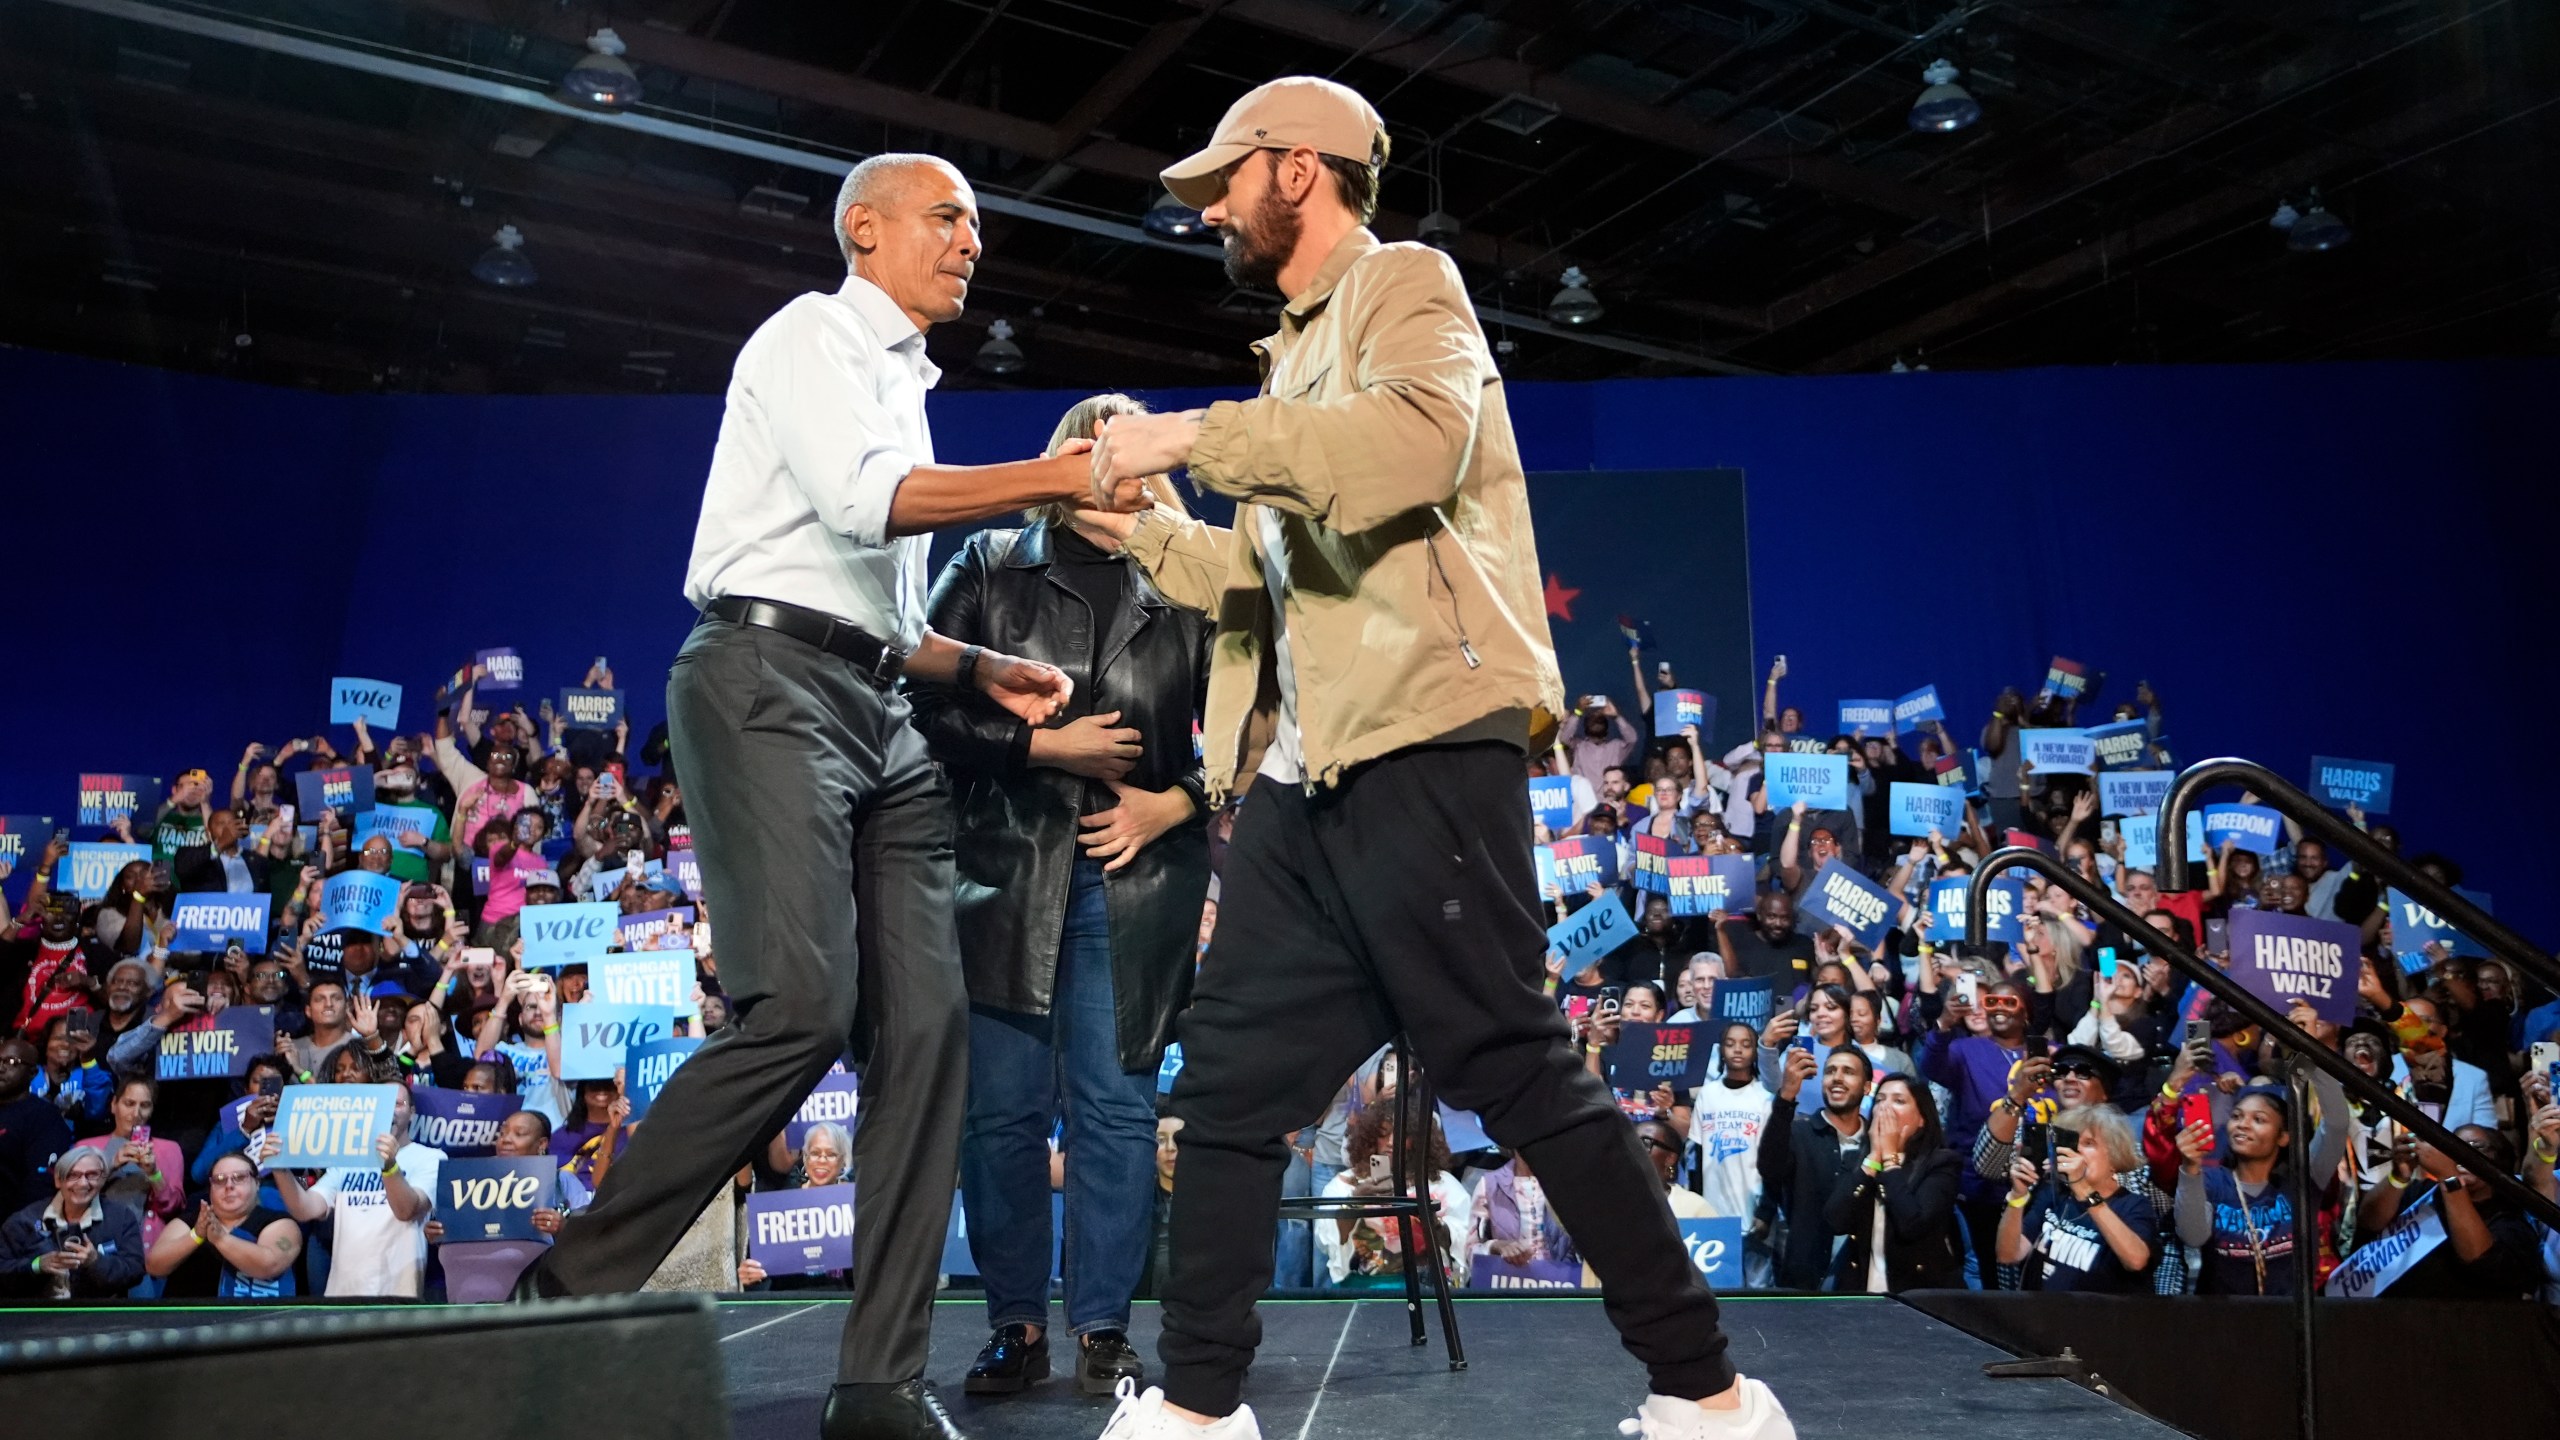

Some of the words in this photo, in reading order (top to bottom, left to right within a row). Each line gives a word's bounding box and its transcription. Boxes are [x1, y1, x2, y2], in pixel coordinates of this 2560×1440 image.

[341, 688, 392, 709] vote
[568, 695, 615, 713] HARRIS
[1676, 692, 1703, 704] YES
[574, 711, 608, 722] WALZ
[1676, 702, 1703, 715] SHE
[1842, 708, 1889, 723] FREEDOM
[1790, 738, 1827, 754] ote
[2033, 743, 2040, 752] A
[2042, 743, 2064, 754] NEW
[2066, 743, 2089, 755] WAY
[2037, 753, 2085, 765] FORWARD
[2104, 751, 2139, 765] WALZ
[1780, 766, 1831, 784] HARRIS
[2320, 766, 2382, 792] HARRIS
[323, 781, 352, 795] SHE
[1788, 785, 1823, 795] WALZ
[2109, 783, 2116, 793] A
[2118, 782, 2141, 794] NEW
[2328, 787, 2370, 802] WALZ
[80, 791, 102, 808] WE
[105, 791, 139, 811] VOTE,
[323, 791, 354, 806] CAN
[1906, 796, 1953, 816] HARRIS
[80, 808, 101, 825] WE
[372, 814, 421, 832] HARRIS
[1913, 814, 1945, 825] WALZ
[2206, 812, 2275, 838] FREEDOM
[1571, 854, 1602, 874] VOTE,
[1668, 878, 1691, 896] WE
[1692, 875, 1730, 896] VOTE,
[330, 884, 383, 907] HARRIS
[1823, 872, 1889, 924] HARRIS
[334, 903, 372, 916] WALZ
[1670, 896, 1692, 915] WE
[1694, 895, 1724, 913] WIN
[1825, 896, 1872, 932] WALZ
[177, 906, 262, 931] FREEDOM
[534, 913, 605, 942] vote
[1555, 907, 1615, 958] vote
[307, 944, 324, 959] TO
[324, 947, 344, 963] MY
[2254, 934, 2343, 979] HARRIS
[604, 960, 681, 976] MICHIGAN
[605, 972, 682, 1006] VOTE!
[2271, 971, 2332, 999] WALZ
[579, 1016, 660, 1049] vote
[1655, 1029, 1692, 1044] YES
[160, 1031, 188, 1055] WE
[192, 1030, 240, 1055] VOTE,
[1651, 1044, 1689, 1060] SHE
[159, 1055, 187, 1078] WE
[193, 1053, 229, 1075] WIN
[1648, 1060, 1687, 1077] CAN
[292, 1096, 377, 1112] MICHIGAN
[1717, 1110, 1760, 1122] AMERICA
[287, 1112, 375, 1156] VOTE!
[1717, 1121, 1743, 1130] TEAM
[450, 1169, 540, 1212] vote
[347, 1195, 387, 1207] WALZ
[2341, 1220, 2422, 1297] FORWARD
